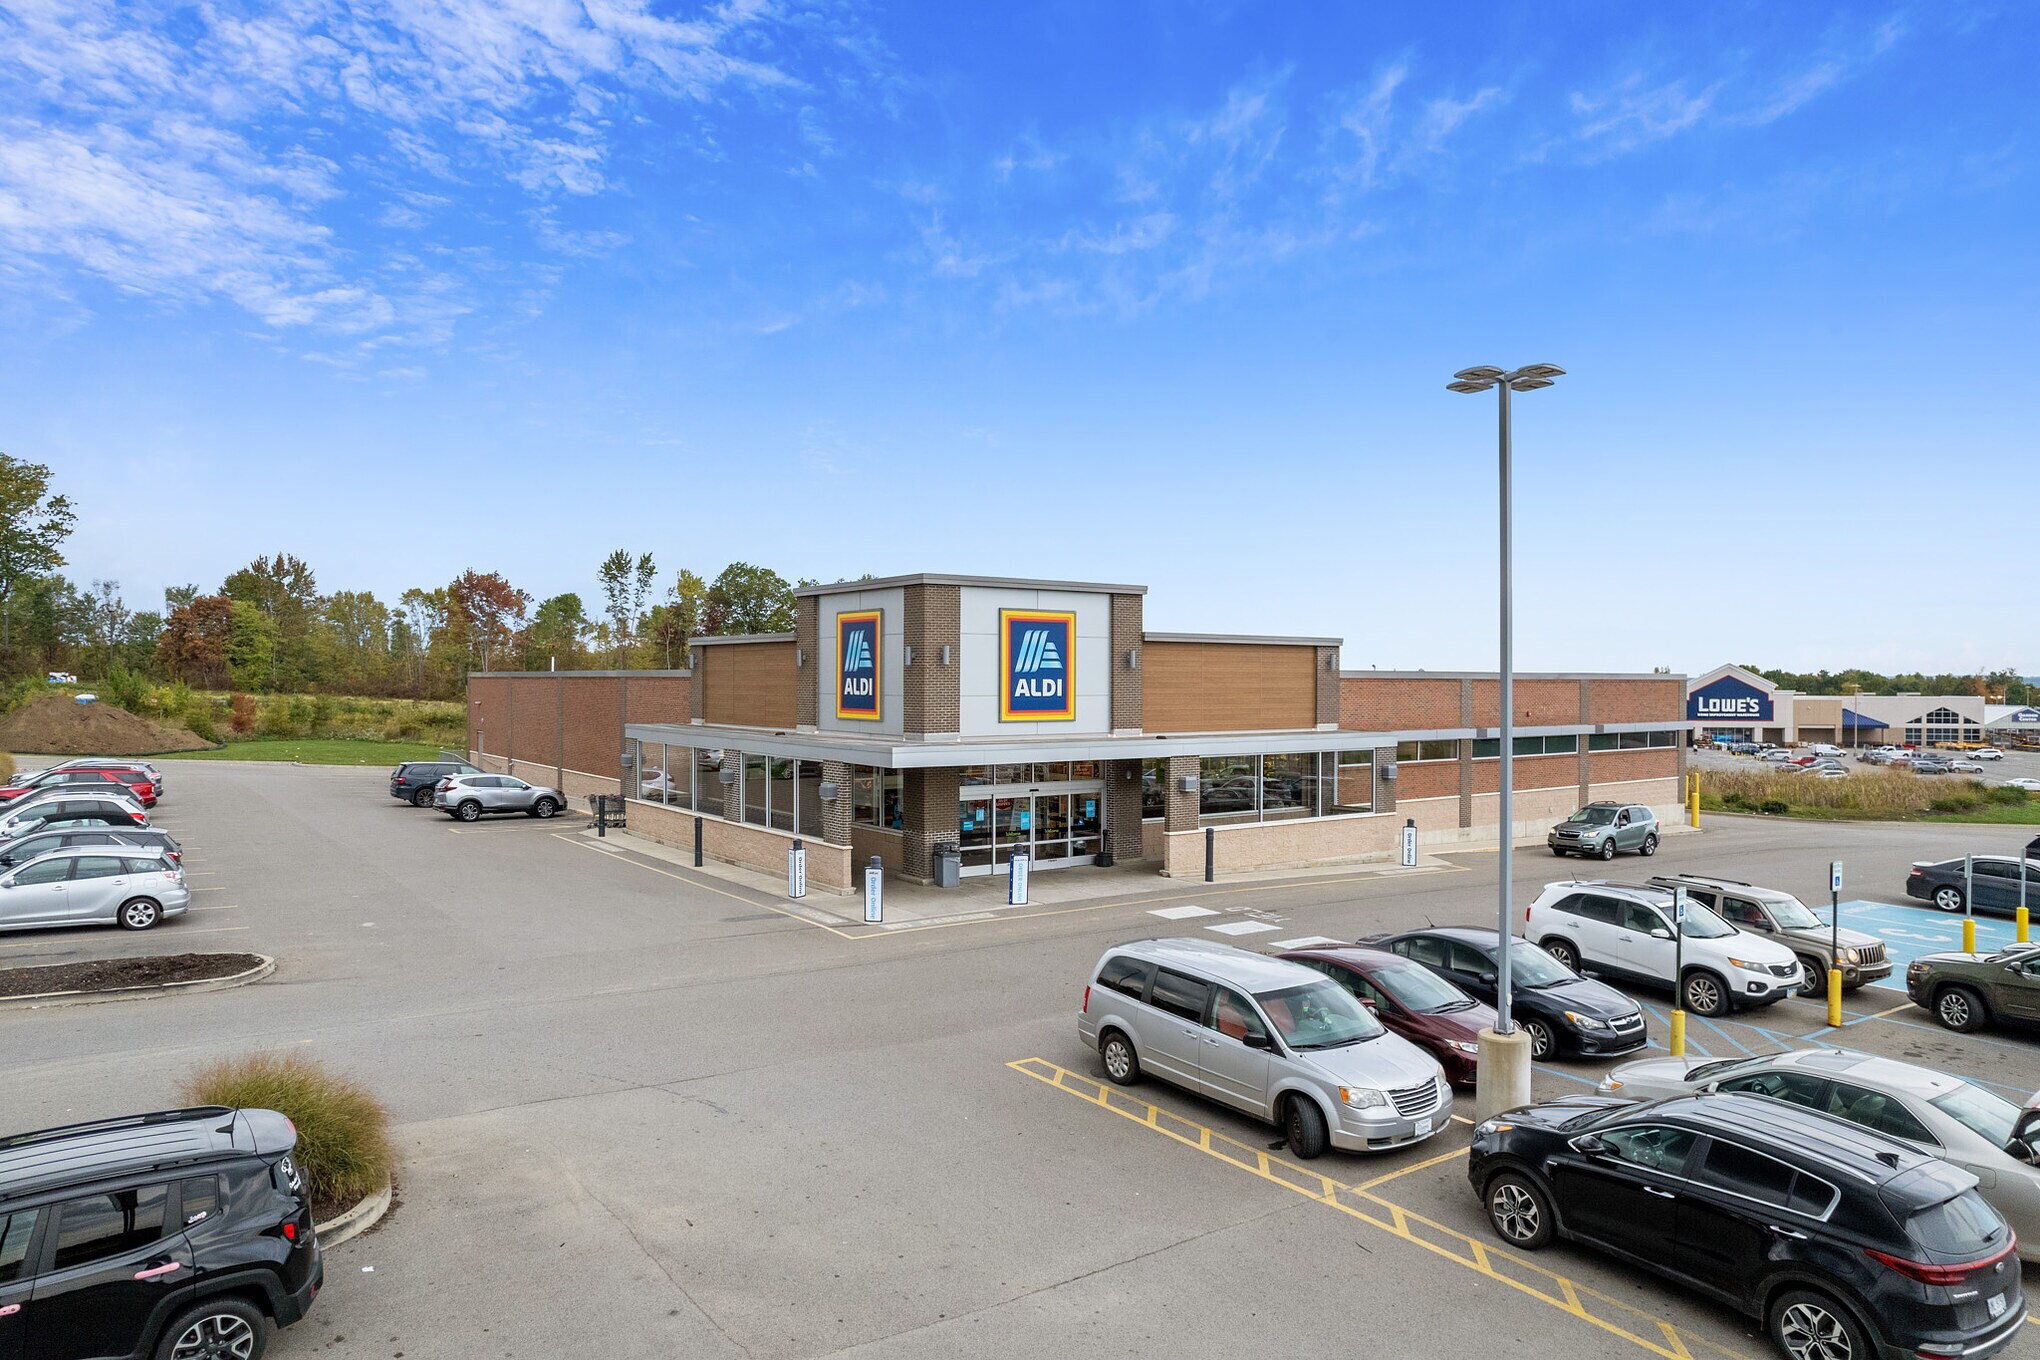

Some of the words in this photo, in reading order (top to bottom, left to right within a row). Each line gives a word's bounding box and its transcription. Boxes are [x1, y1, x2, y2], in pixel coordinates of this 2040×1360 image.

[844, 677, 873, 696] ALDI
[1014, 678, 1063, 697] ALDI
[1698, 696, 1760, 712] LOWE'S
